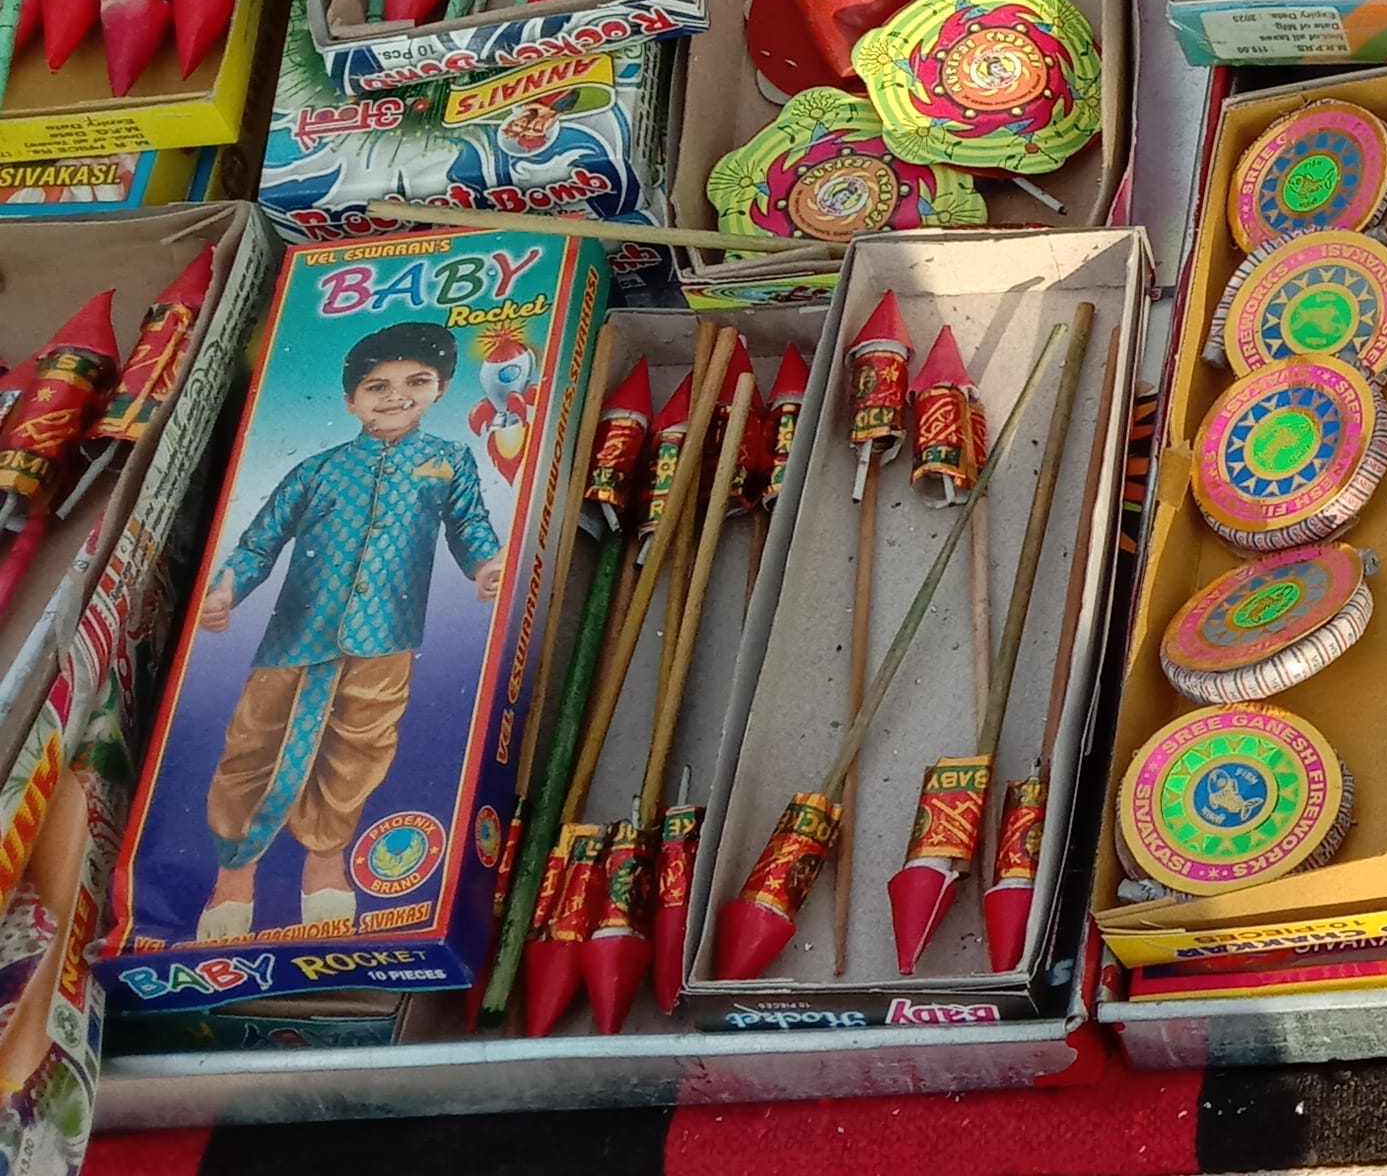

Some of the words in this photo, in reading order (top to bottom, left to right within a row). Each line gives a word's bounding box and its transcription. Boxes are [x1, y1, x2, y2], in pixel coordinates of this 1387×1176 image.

[1271, 12, 1297, 21] Date
[1300, 10, 1337, 21] Expiry
[1312, 22, 1340, 31] Date
[421, 43, 443, 59] 10
[459, 55, 603, 117] ANNAI'S
[484, 176, 614, 217] Bomb
[305, 251, 338, 267] VEL
[342, 239, 452, 262] ESWARAN'S
[318, 248, 540, 317] BABY
[446, 294, 549, 330] Rocket
[508, 562, 549, 704] ESWARAN
[537, 388, 579, 555] FIREWORKS,
[572, 267, 601, 385] SIVAKASI
[1162, 719, 1223, 754] SREE
[1230, 713, 1319, 770] GANESH
[366, 813, 437, 841] PHOENIX
[1132, 781, 1194, 878] SIVAKASI
[1232, 767, 1328, 880] FIREWORKS
[369, 875, 422, 895] BRAND
[119, 952, 277, 1001] BABY
[291, 945, 427, 981] ROCKET
[366, 970, 382, 981] 10
[384, 967, 447, 981] PIECES
